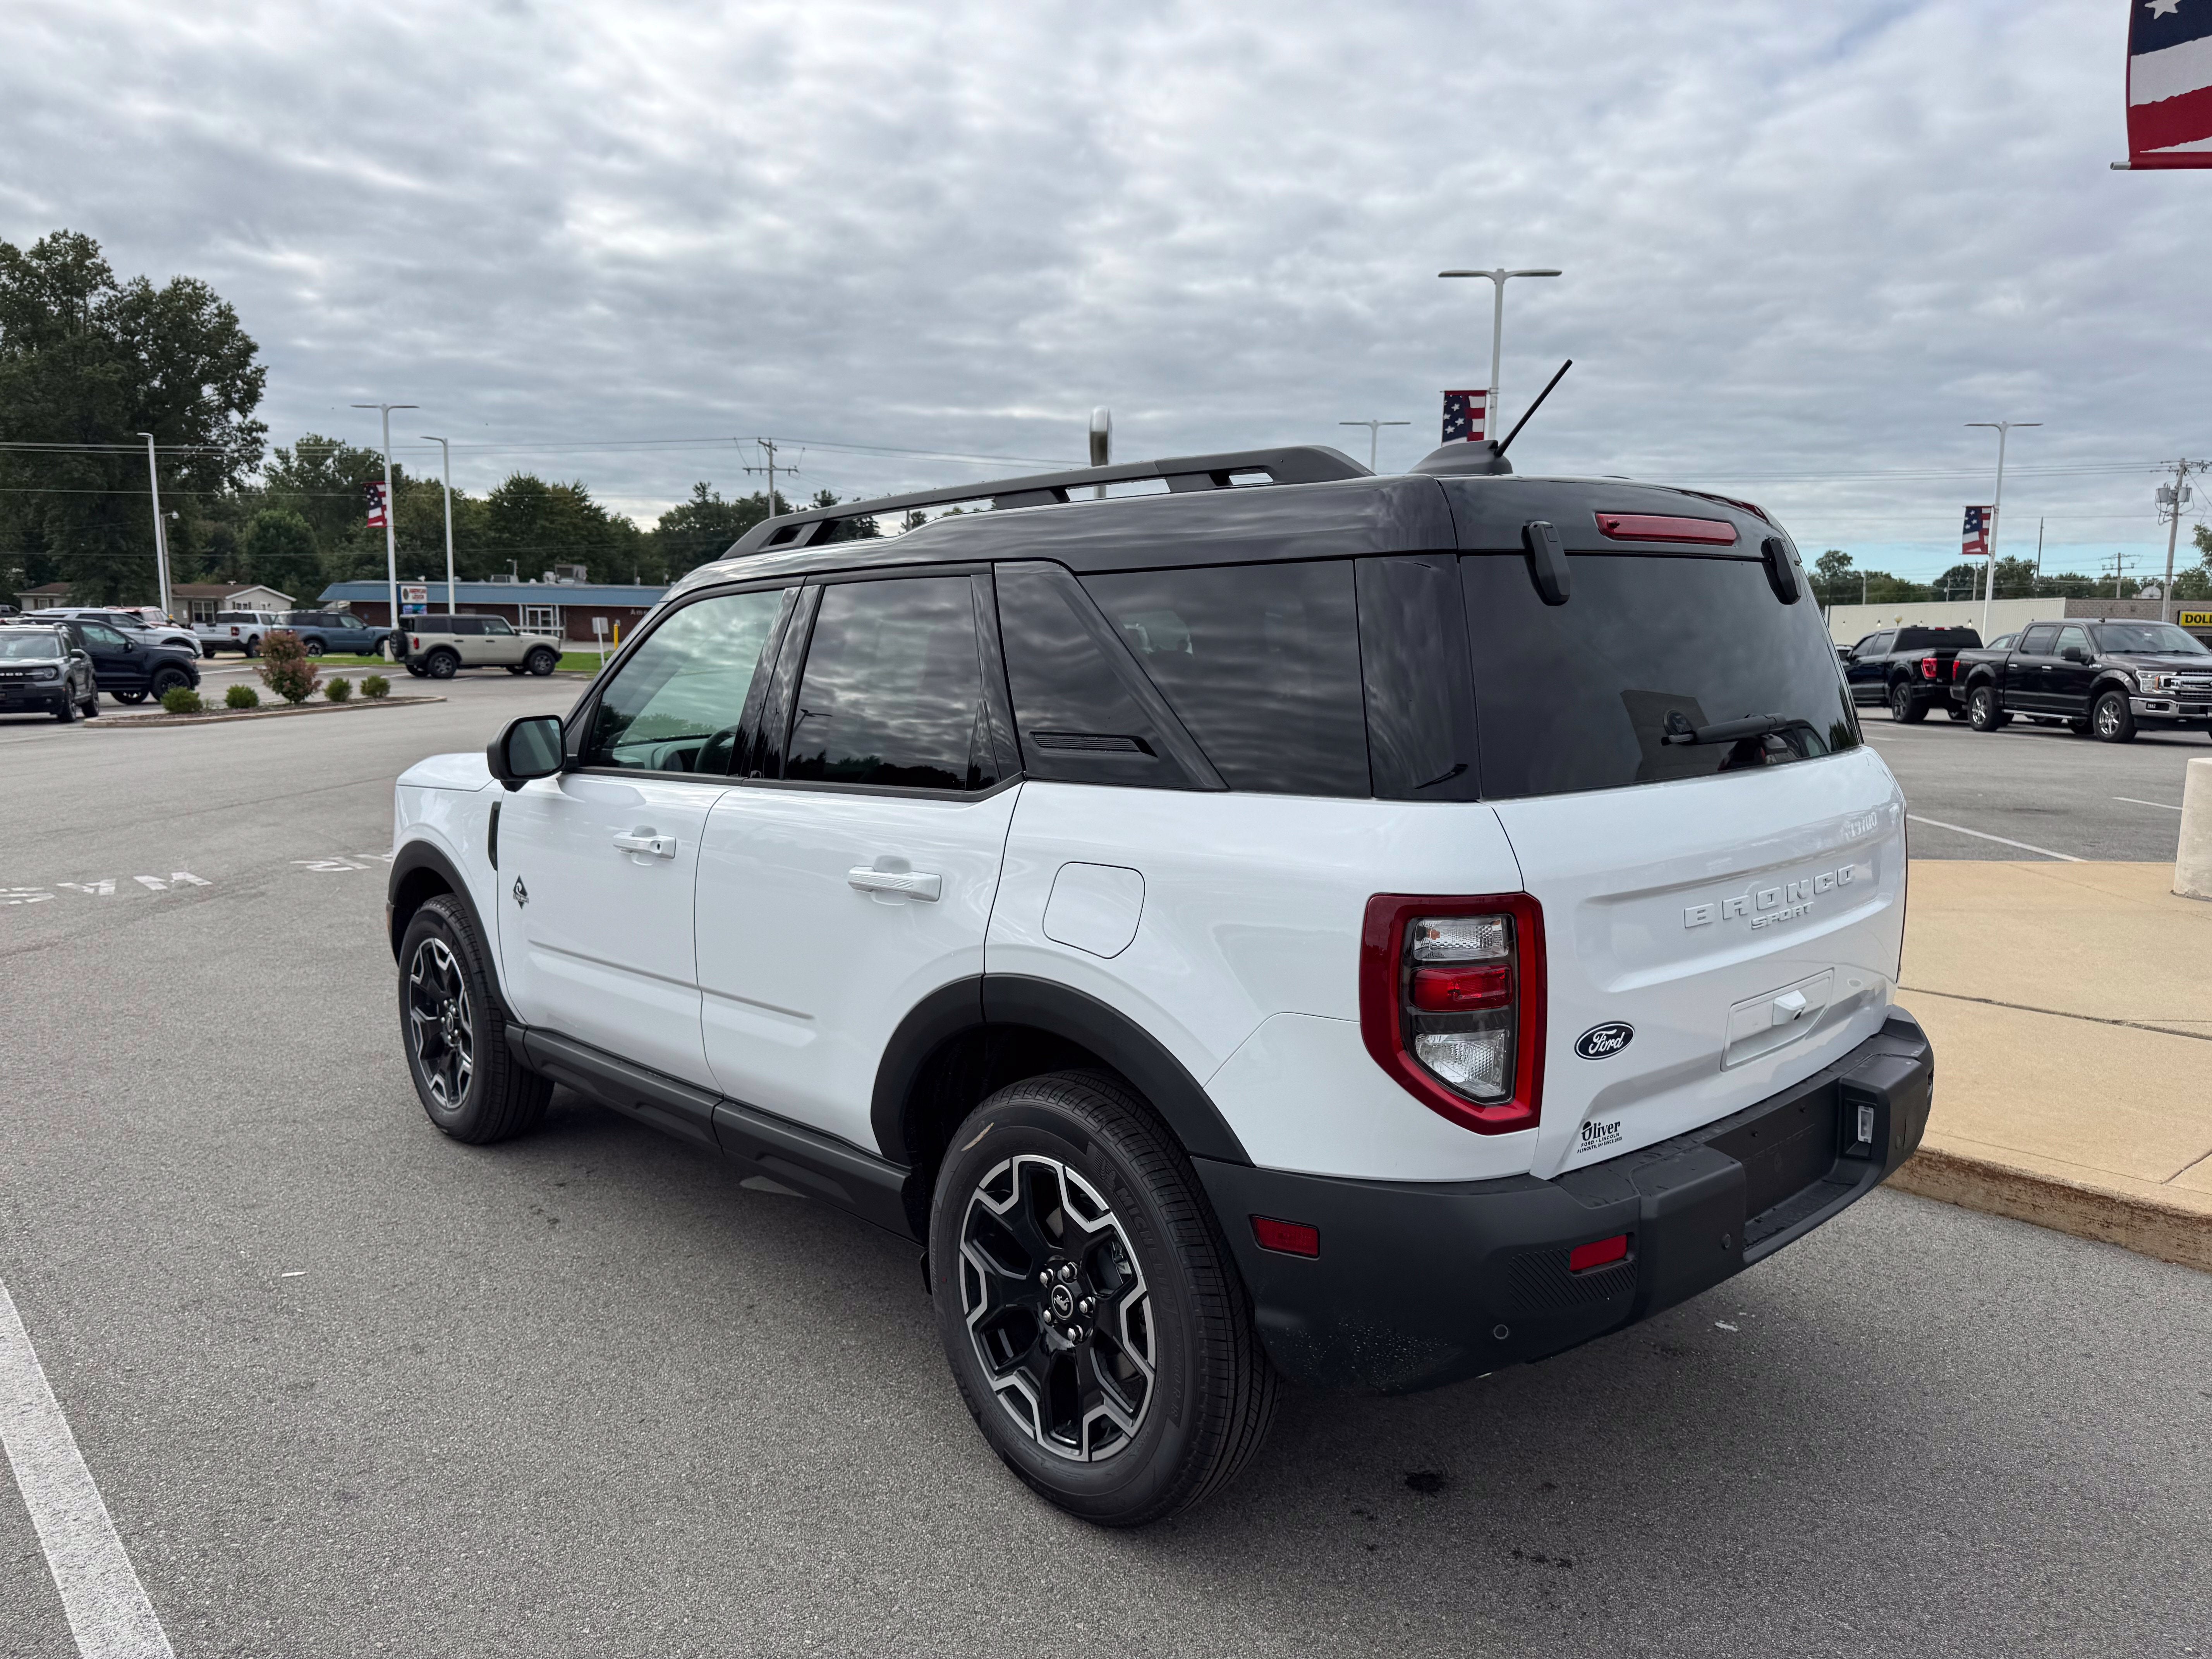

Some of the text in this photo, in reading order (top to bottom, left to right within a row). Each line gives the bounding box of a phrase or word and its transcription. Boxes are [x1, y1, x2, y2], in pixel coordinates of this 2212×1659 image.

[1684, 864, 1855, 929] BRONCO
[1751, 902, 1814, 930] SPORT
[1589, 1029, 1625, 1054] Ford
[1581, 1121, 1620, 1141] Oliver
[1581, 1132, 1619, 1148] FORD LINCOLN
[1116, 1187, 1173, 1308] MICHELIN
